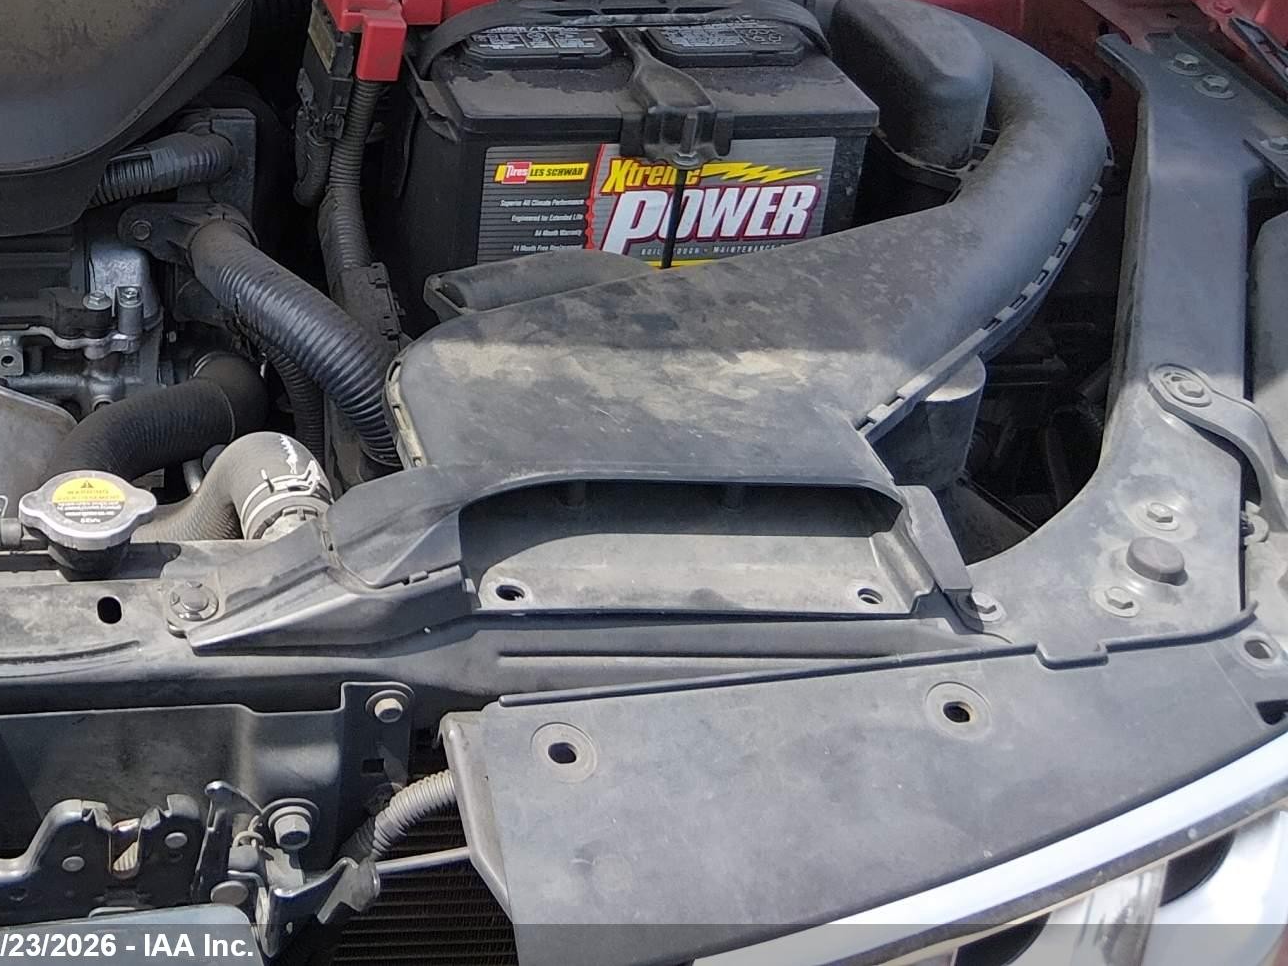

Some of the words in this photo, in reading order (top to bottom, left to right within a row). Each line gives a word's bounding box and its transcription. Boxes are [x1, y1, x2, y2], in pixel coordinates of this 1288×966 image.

[530, 168, 544, 176] LES
[546, 168, 583, 176] SCHWAB
[602, 185, 816, 255] POWER
